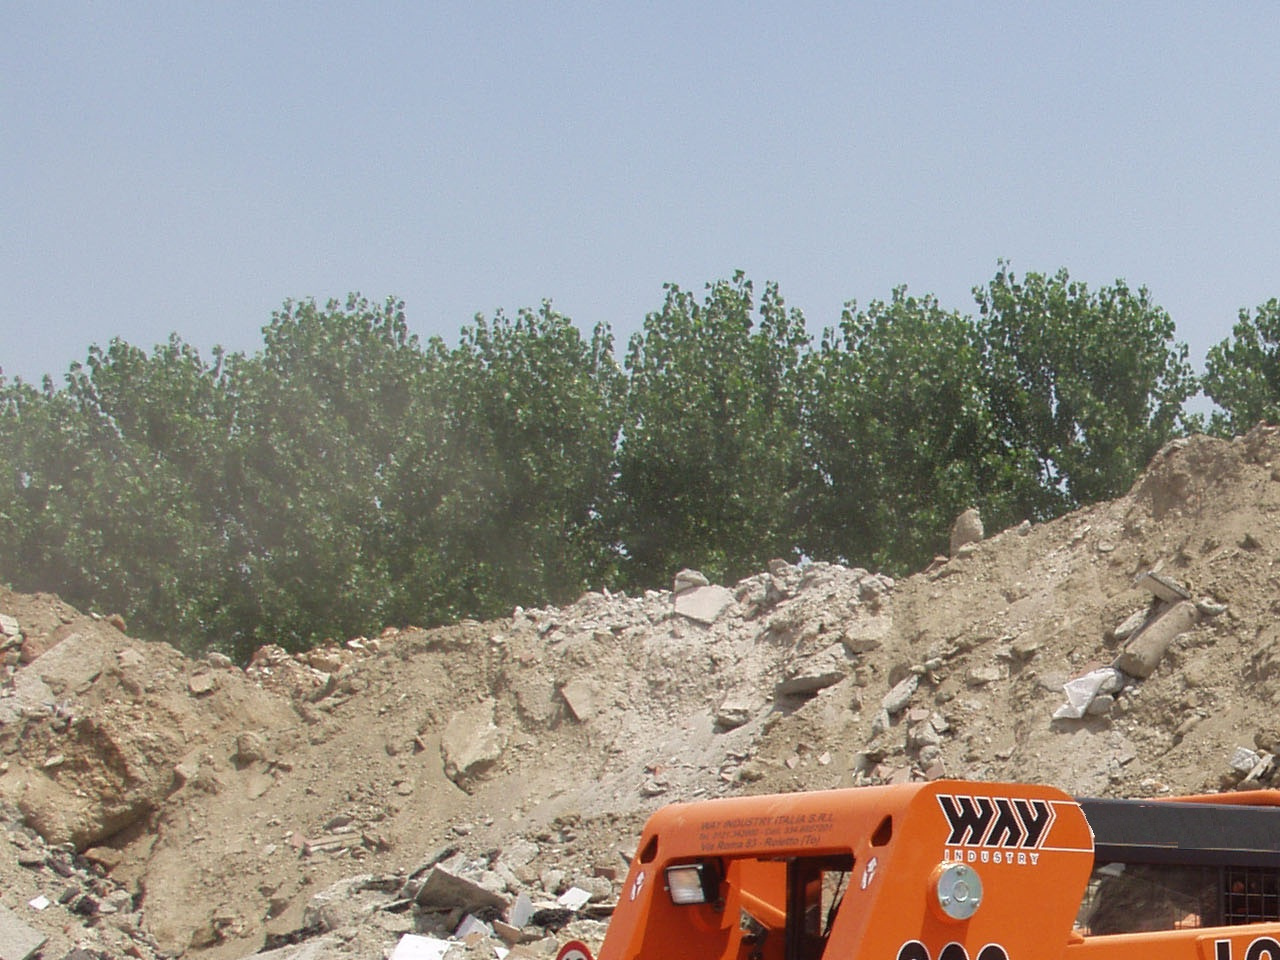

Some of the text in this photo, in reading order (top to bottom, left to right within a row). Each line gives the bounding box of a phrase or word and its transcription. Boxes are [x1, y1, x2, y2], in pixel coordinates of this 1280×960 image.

[724, 816, 774, 829] INDUSTRY
[937, 795, 1051, 849] WAY
[944, 849, 1039, 865] INDUSTRY
